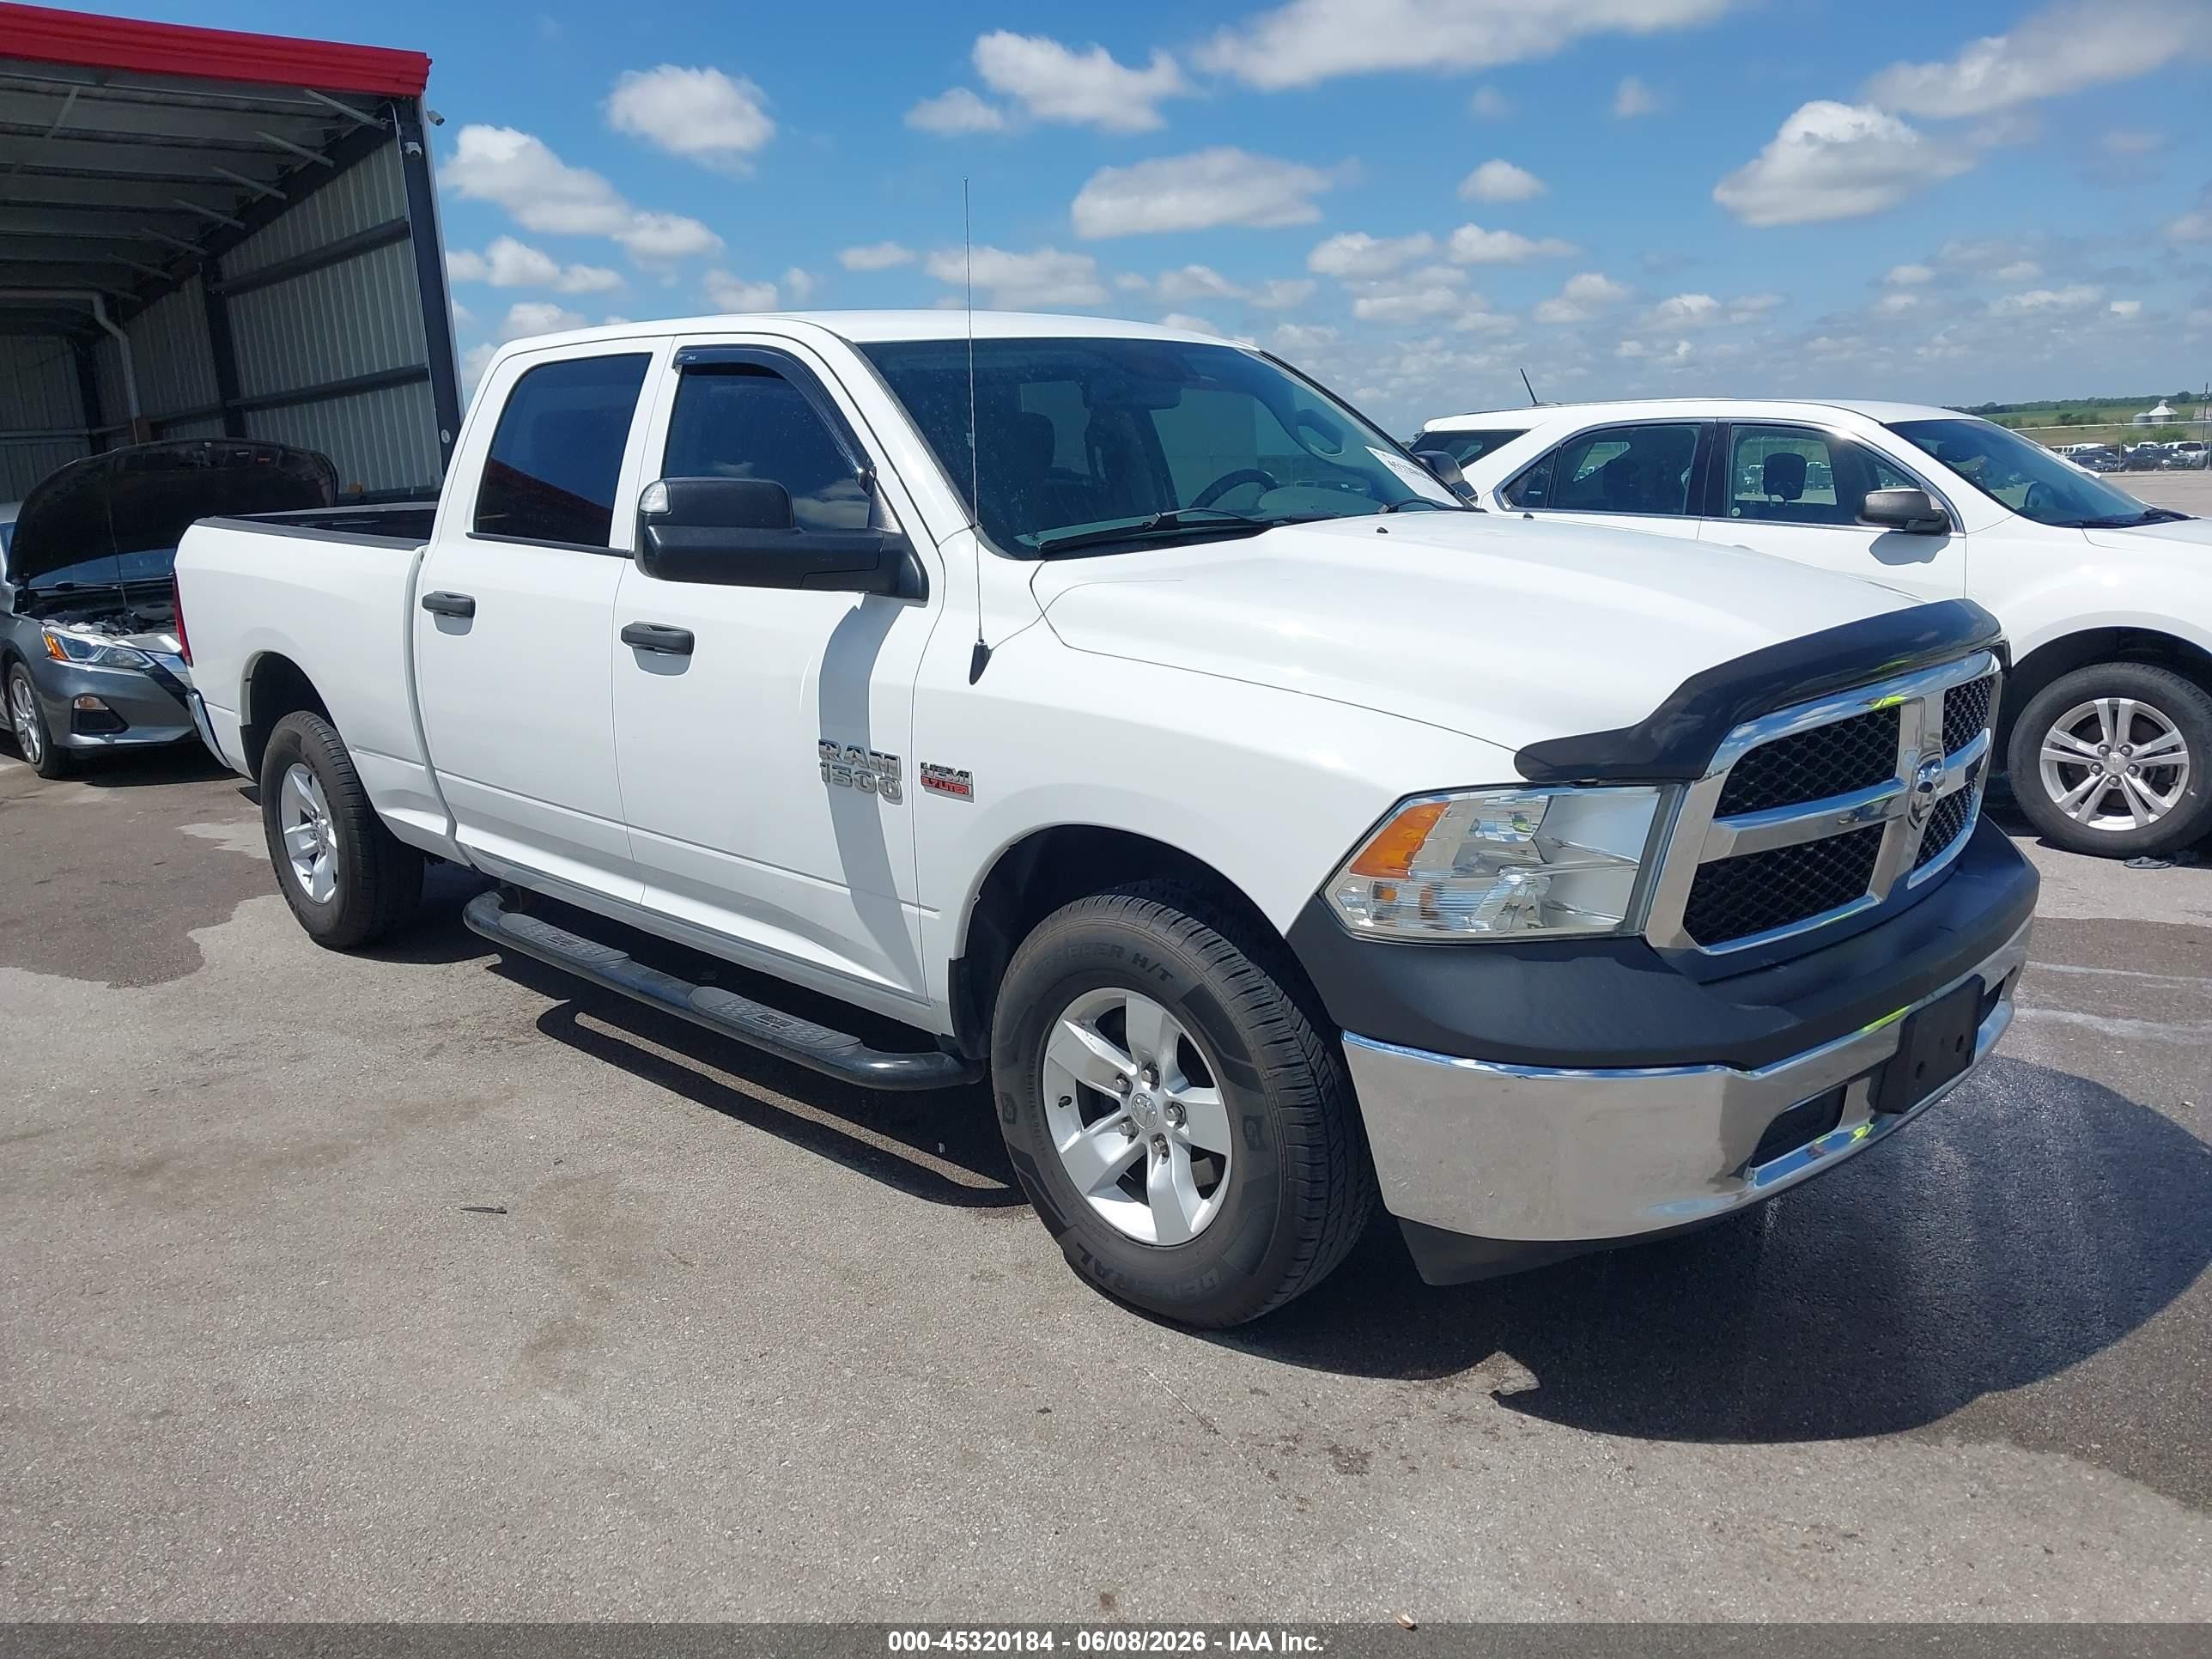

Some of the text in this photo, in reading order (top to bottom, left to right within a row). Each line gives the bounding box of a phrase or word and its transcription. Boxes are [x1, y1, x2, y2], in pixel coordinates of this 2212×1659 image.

[818, 739, 902, 781] RAM
[921, 763, 972, 785] HEMI
[820, 763, 902, 800] 1500
[921, 776, 969, 795] 5.7 LITER
[1131, 952, 1176, 983] H/T
